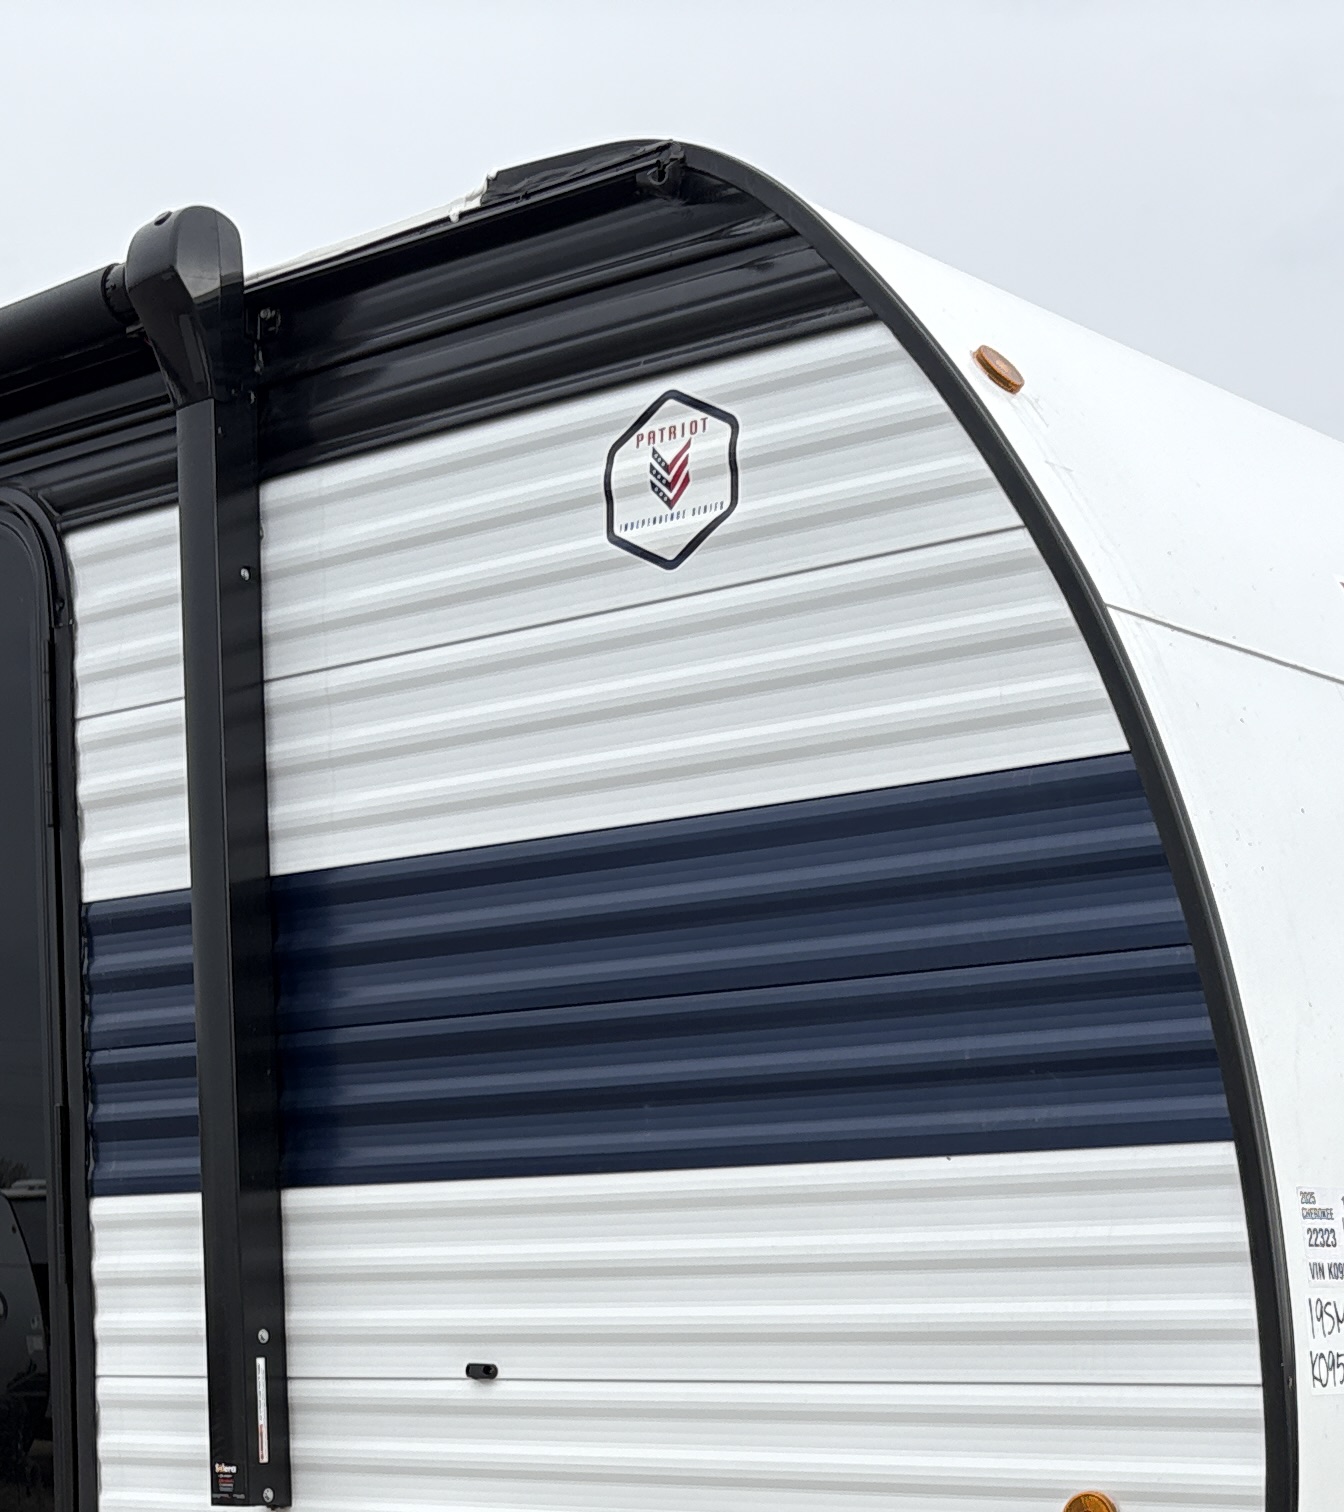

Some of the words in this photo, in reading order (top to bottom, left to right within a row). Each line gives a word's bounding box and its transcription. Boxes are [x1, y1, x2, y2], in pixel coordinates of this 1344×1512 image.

[636, 417, 709, 448] PATRIOT
[620, 509, 686, 533] INDEPENDENCE
[1307, 1228, 1337, 1248] 22323
[1309, 1262, 1325, 1280] VIN
